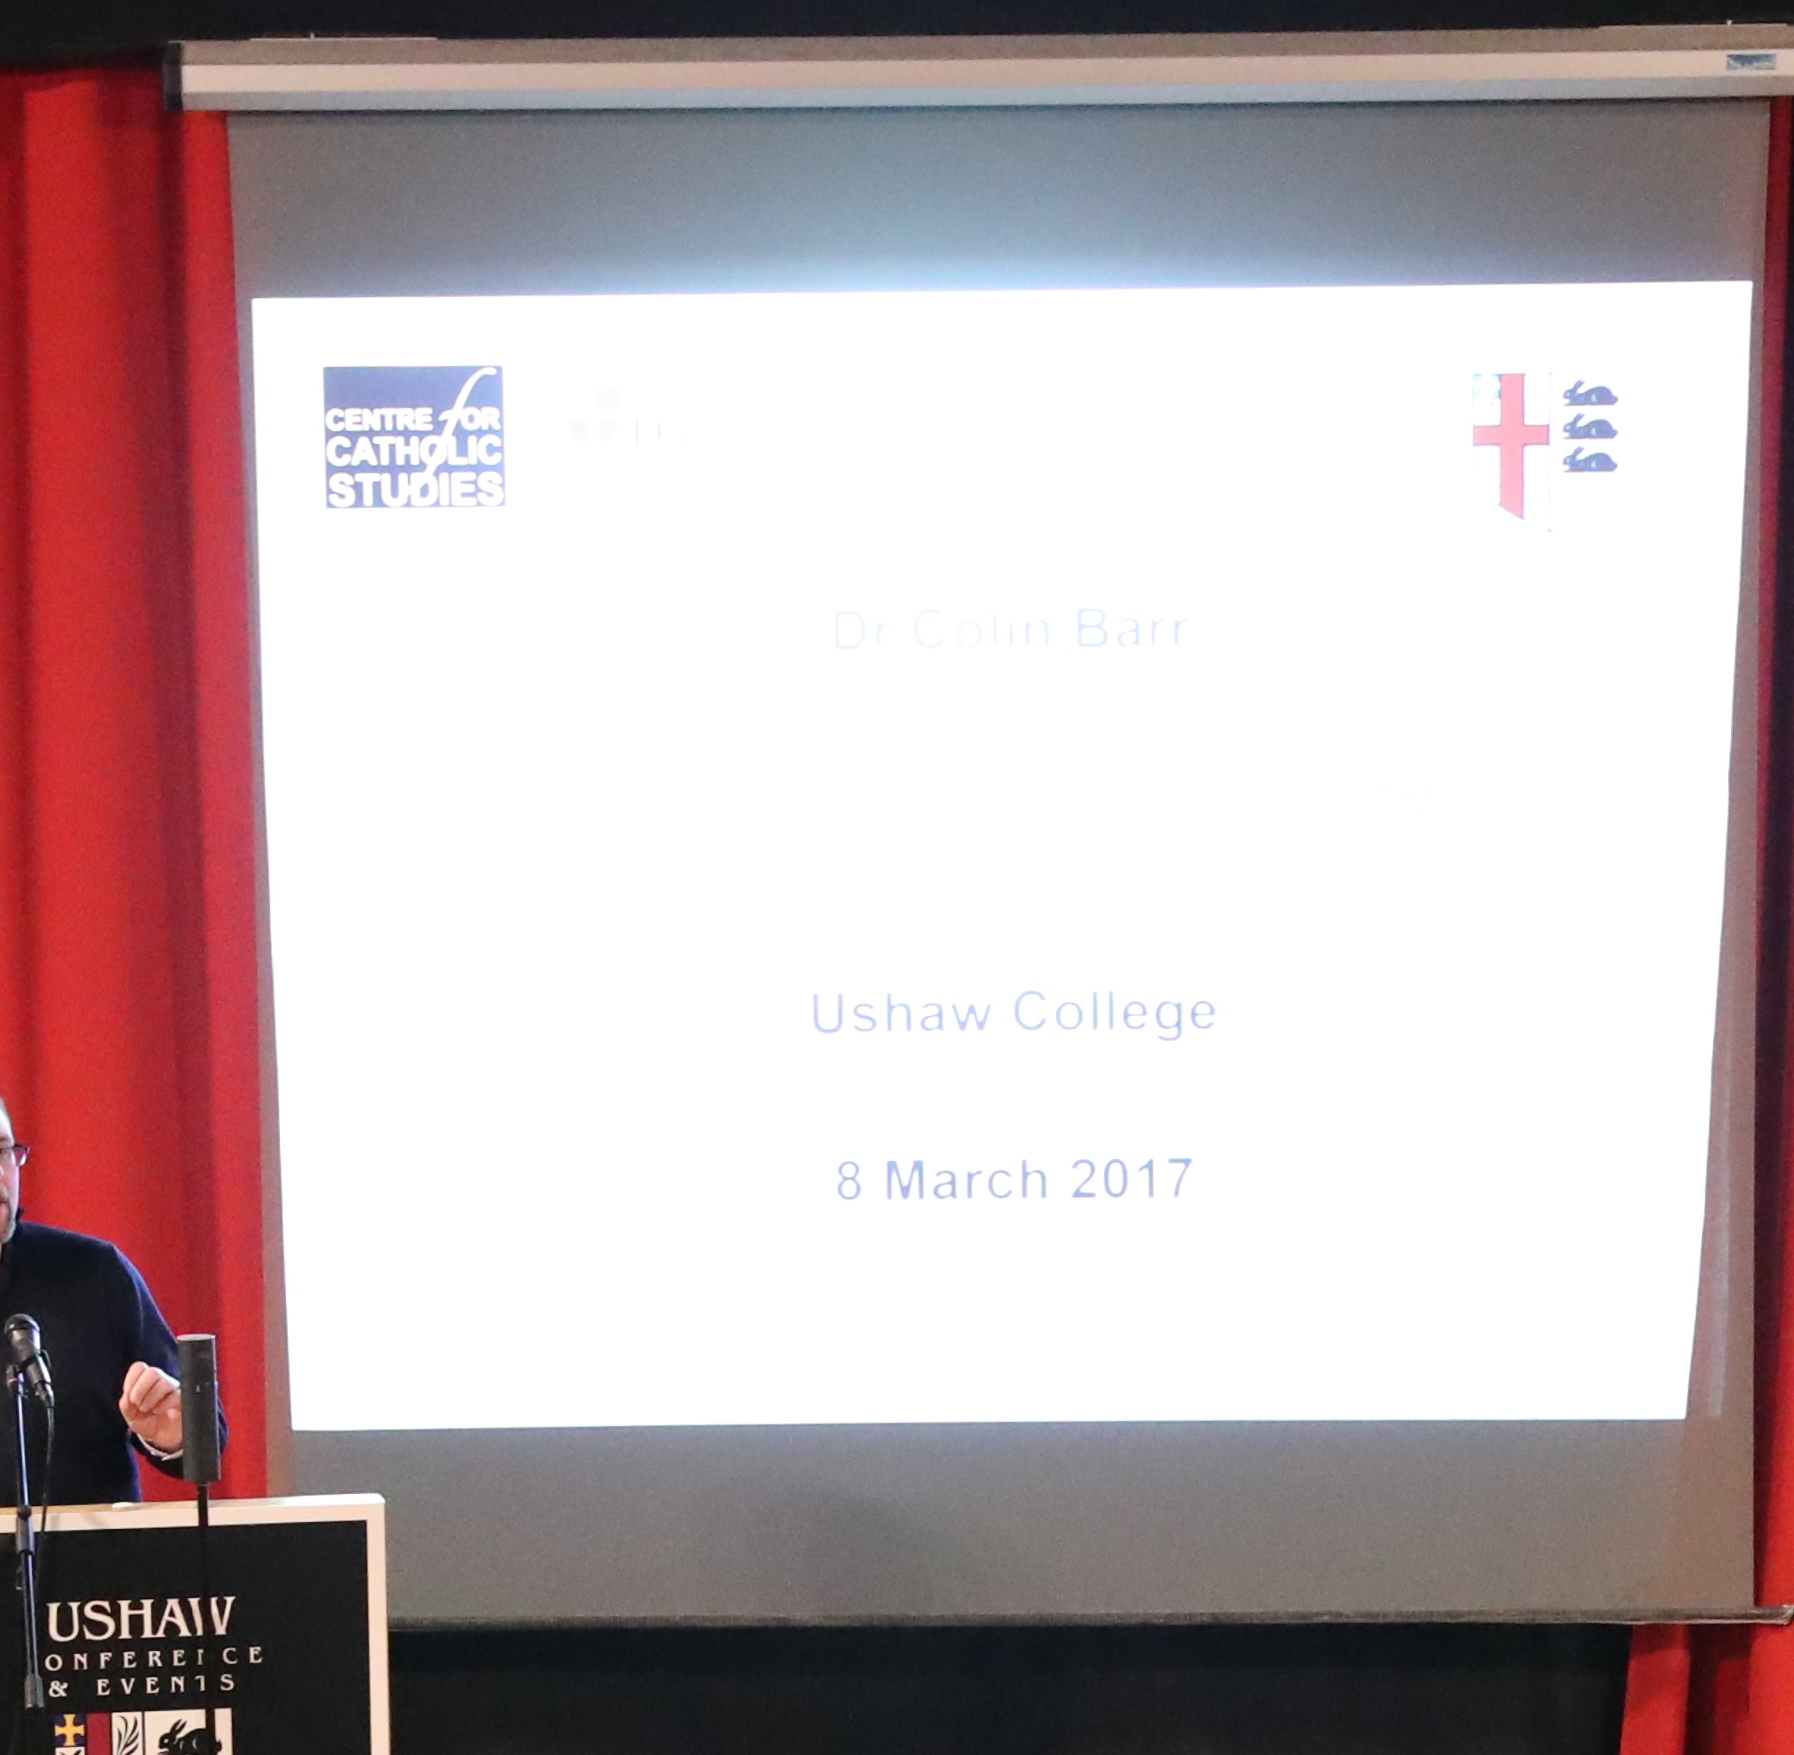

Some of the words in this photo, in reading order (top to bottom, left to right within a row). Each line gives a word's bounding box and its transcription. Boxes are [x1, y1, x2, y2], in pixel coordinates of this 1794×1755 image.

[325, 407, 434, 432] CENTRE
[325, 434, 503, 467] CATHOLIC
[328, 471, 505, 508] STUDIES
[835, 609, 889, 650] Dr
[1076, 607, 1188, 648] Barr
[813, 992, 991, 1034] Ushaw
[1013, 990, 1216, 1042] College
[837, 1160, 862, 1201] 8
[886, 1159, 1047, 1200] March
[1071, 1158, 1193, 1198] 2017
[46, 1596, 236, 1642] USHAW
[48, 1680, 68, 1698] &
